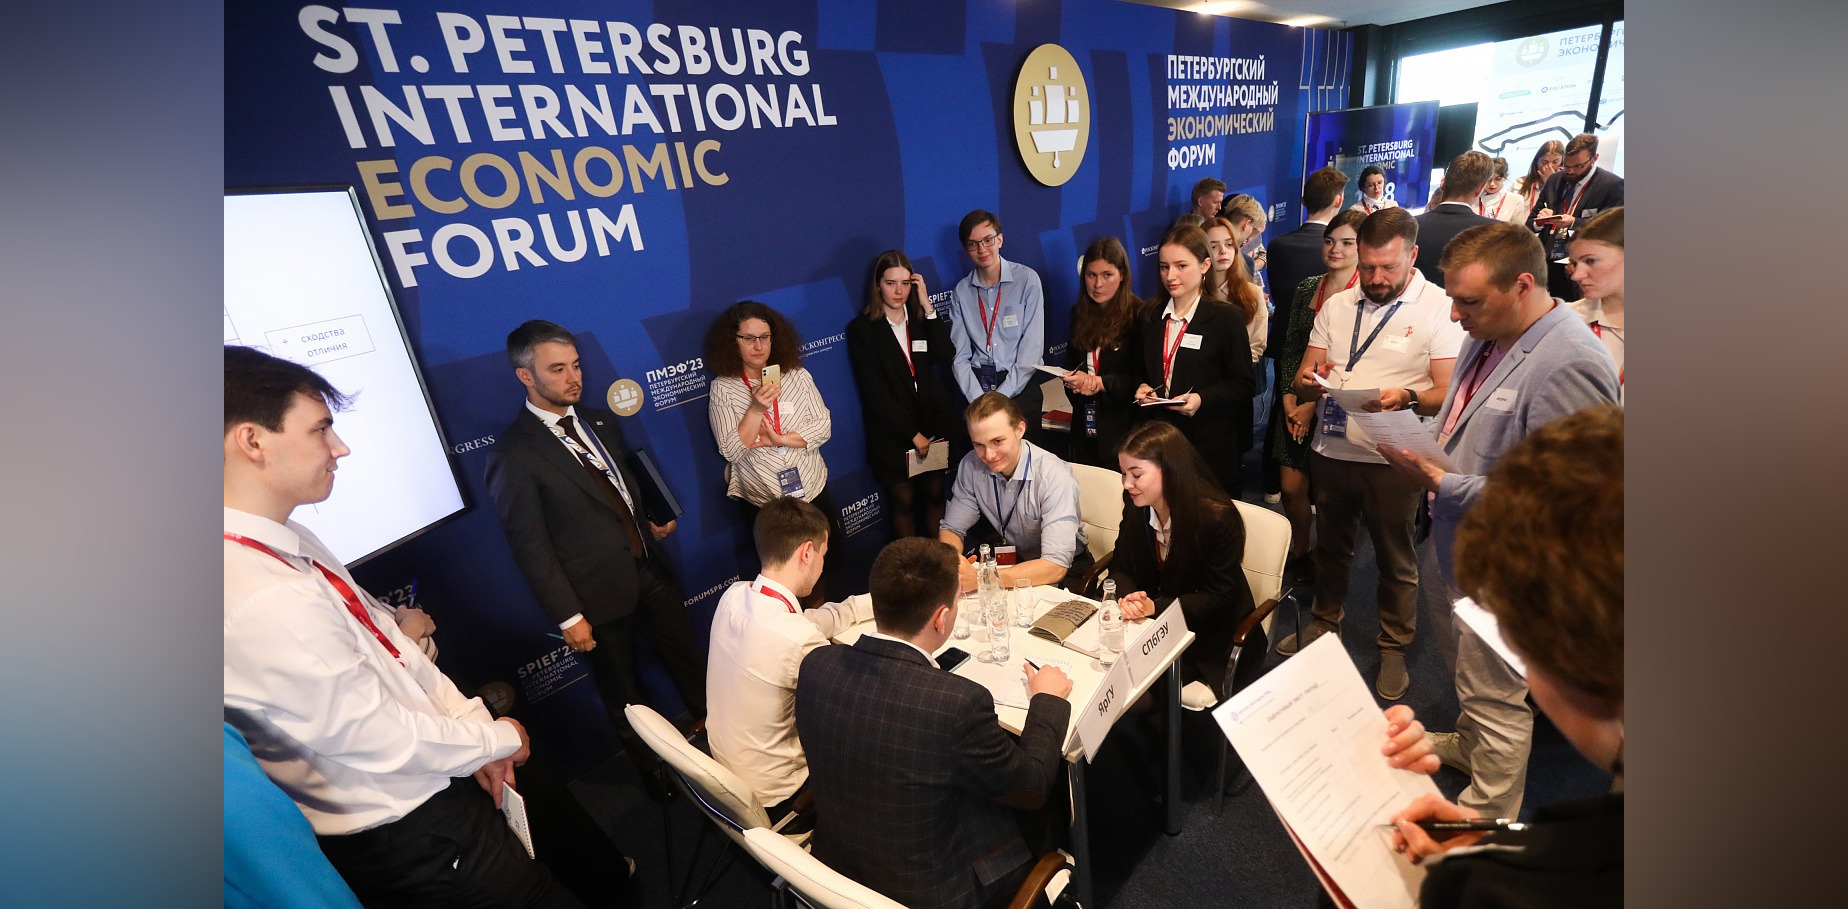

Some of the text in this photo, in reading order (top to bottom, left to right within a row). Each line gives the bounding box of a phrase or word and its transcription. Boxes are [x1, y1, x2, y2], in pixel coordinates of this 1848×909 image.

[298, 4, 811, 76] ST. PETERSBURG
[1168, 55, 1265, 80] ПЕТЕРБУРГСКИЙ
[1168, 81, 1278, 111] МЕЖДУНАРОДНЫЙ
[328, 84, 838, 149] INTERNATIONAL
[1168, 107, 1274, 141] ЭКОНОМИЧЕСКИЙ
[1168, 143, 1215, 170] ФОРУМ
[1357, 149, 1415, 163] INTERNATIONAL
[1368, 140, 1413, 153] PETERSBURG
[356, 139, 729, 221] ECONOMIC
[383, 203, 645, 288] FORUM
[301, 328, 345, 343] сходства
[799, 333, 846, 352] ОСКОНГРЕСС
[307, 343, 348, 357] отличия
[649, 371, 697, 390] ПЕТЕРБУРГСКИЙ
[651, 374, 706, 396] МЕЖДУНАРОДНЫЙ
[653, 381, 706, 402] ЭКОНОМИЧЕСКИЙ
[654, 397, 677, 407] ФОРУМ
[683, 575, 740, 608] FORUMSPB.COM
[1142, 622, 1169, 656] СПбГЭУ
[517, 645, 575, 679] SPIEF'2
[1098, 684, 1114, 716] ЯрГУ
